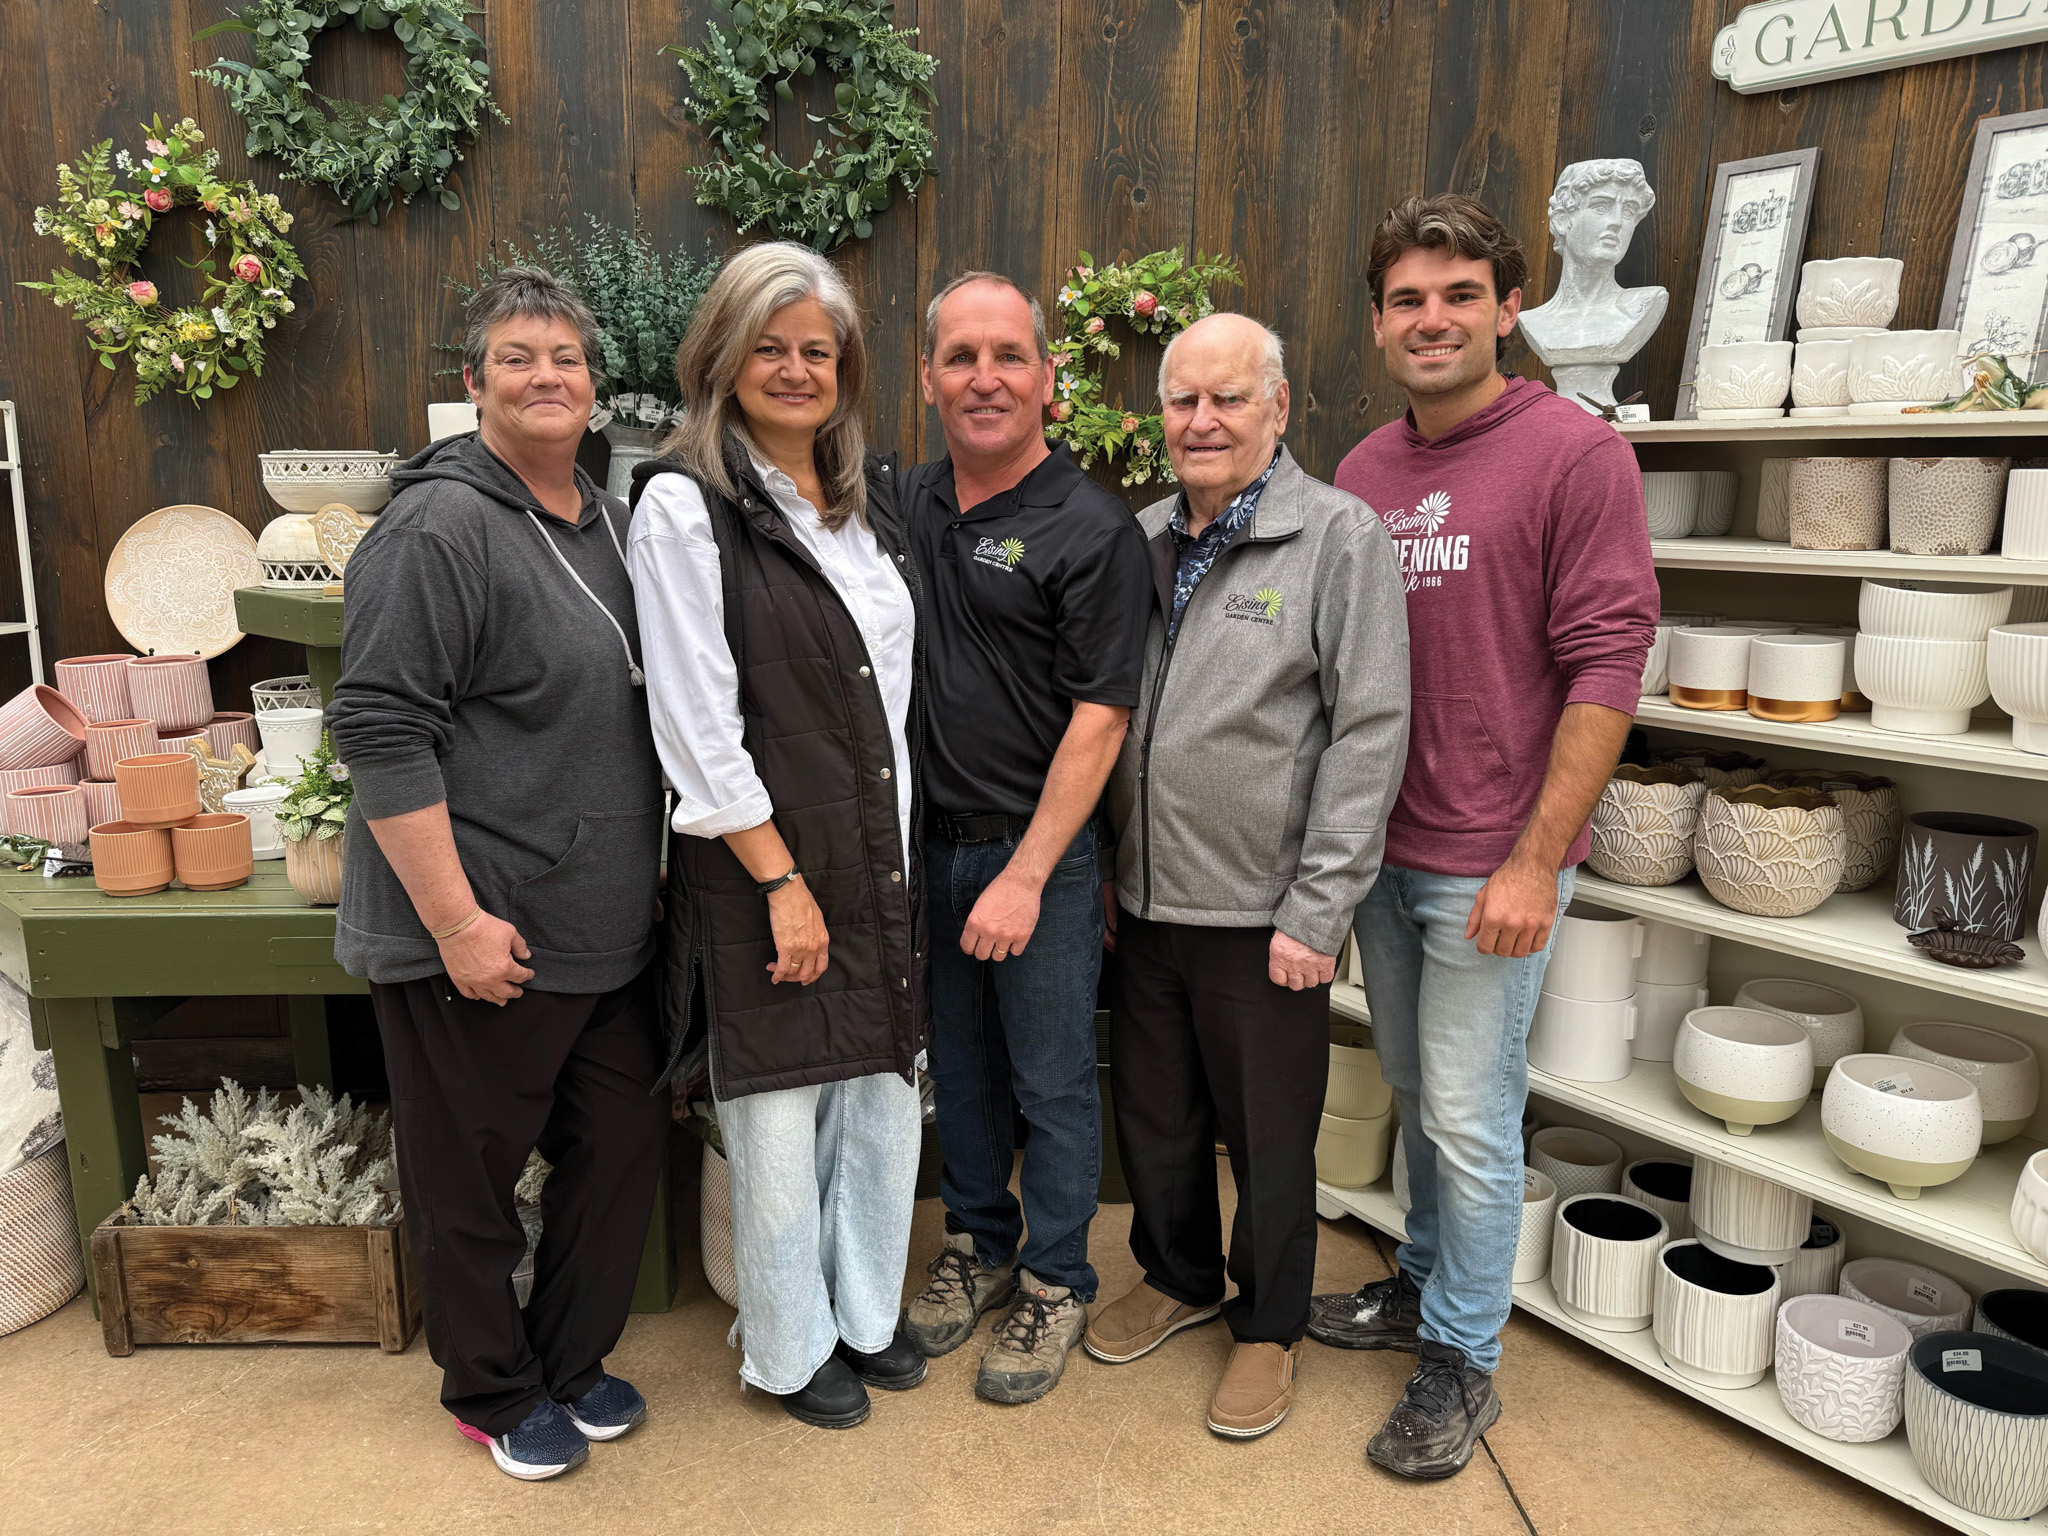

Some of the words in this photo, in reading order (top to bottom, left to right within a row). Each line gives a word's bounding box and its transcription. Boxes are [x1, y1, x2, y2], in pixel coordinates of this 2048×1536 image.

[1755, 0, 2048, 66] GARD
[1383, 508, 1434, 536] Eising
[974, 537, 1012, 561] Eising
[973, 555, 992, 565] GARDEN
[992, 560, 1014, 573] CENTRE
[1422, 575, 1442, 587] 1966
[1224, 593, 1270, 616] Eising
[1224, 612, 1250, 621] GARDEN
[1250, 616, 1274, 626] CENTRE
